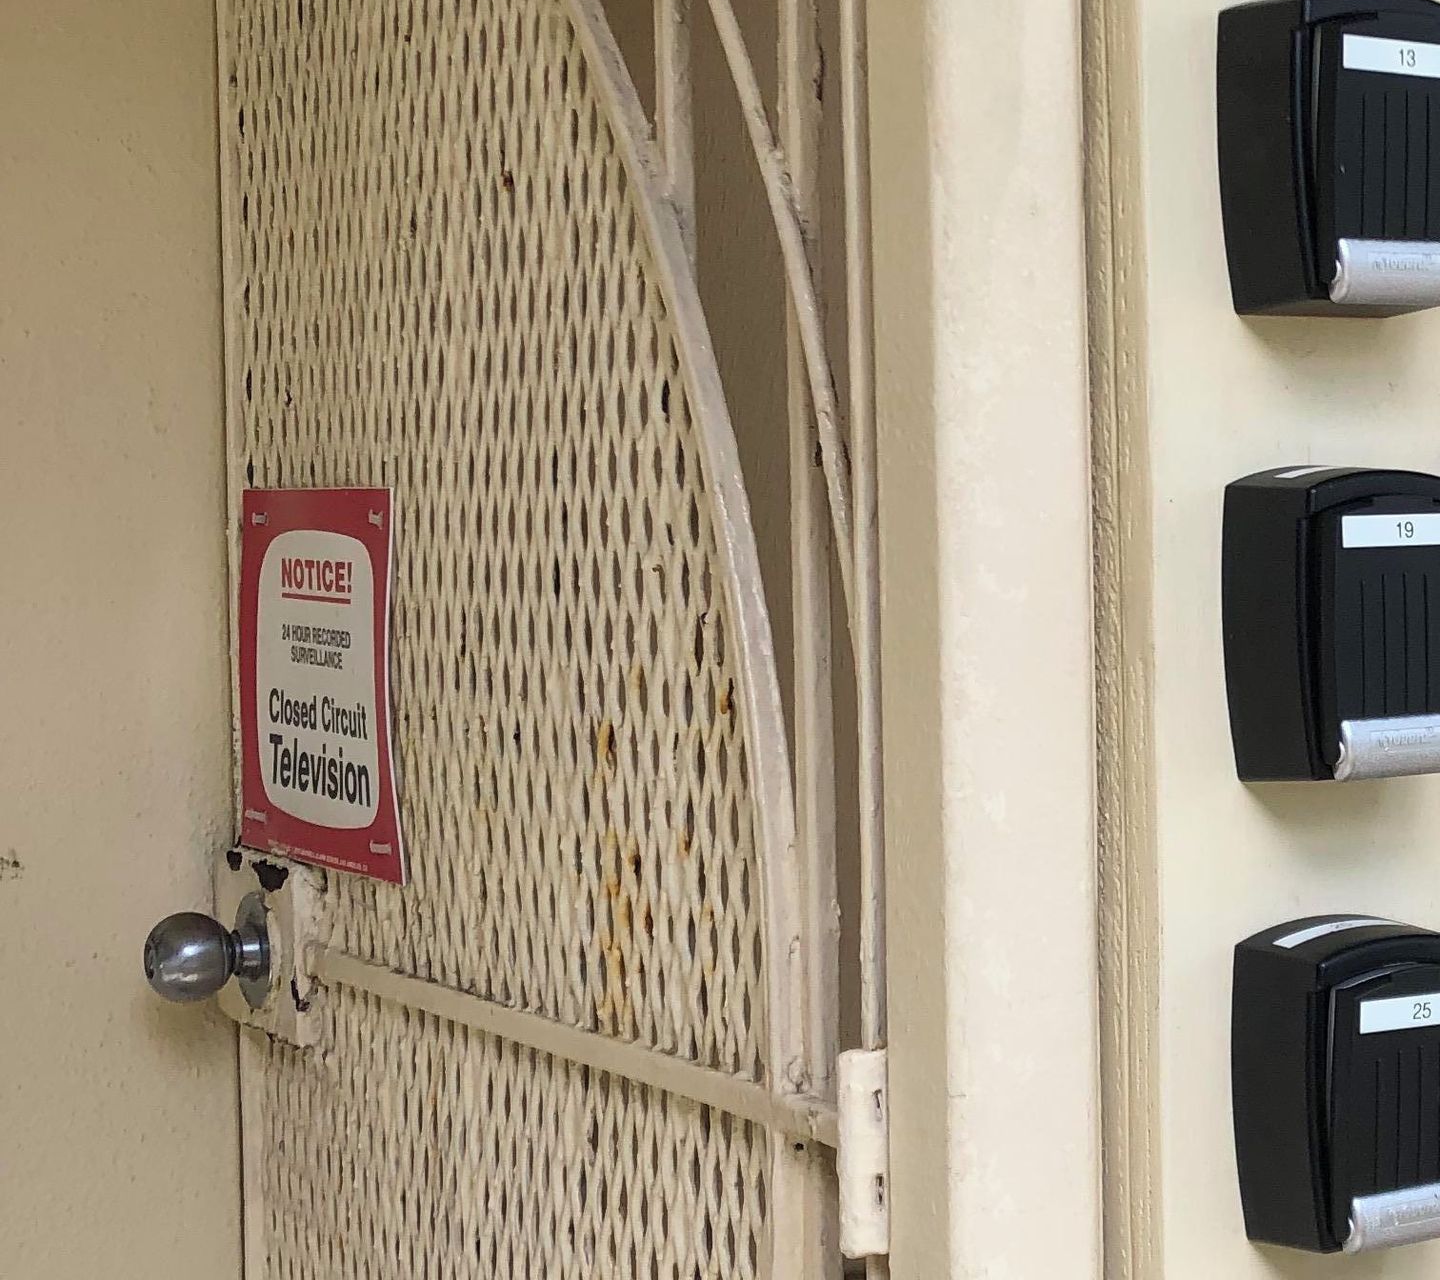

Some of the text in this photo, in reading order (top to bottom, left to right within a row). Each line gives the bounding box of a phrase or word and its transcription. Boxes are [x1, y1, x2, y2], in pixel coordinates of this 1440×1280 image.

[1399, 48, 1416, 68] 13
[1396, 521, 1414, 539] 19
[281, 557, 353, 594] NOTICE!
[281, 623, 352, 650] 24 HOUR RECORDED
[290, 644, 343, 670] SURVEILLANCE
[269, 687, 368, 741] Closed Circuit
[269, 733, 371, 808] Television
[1412, 1001, 1432, 1020] 25
